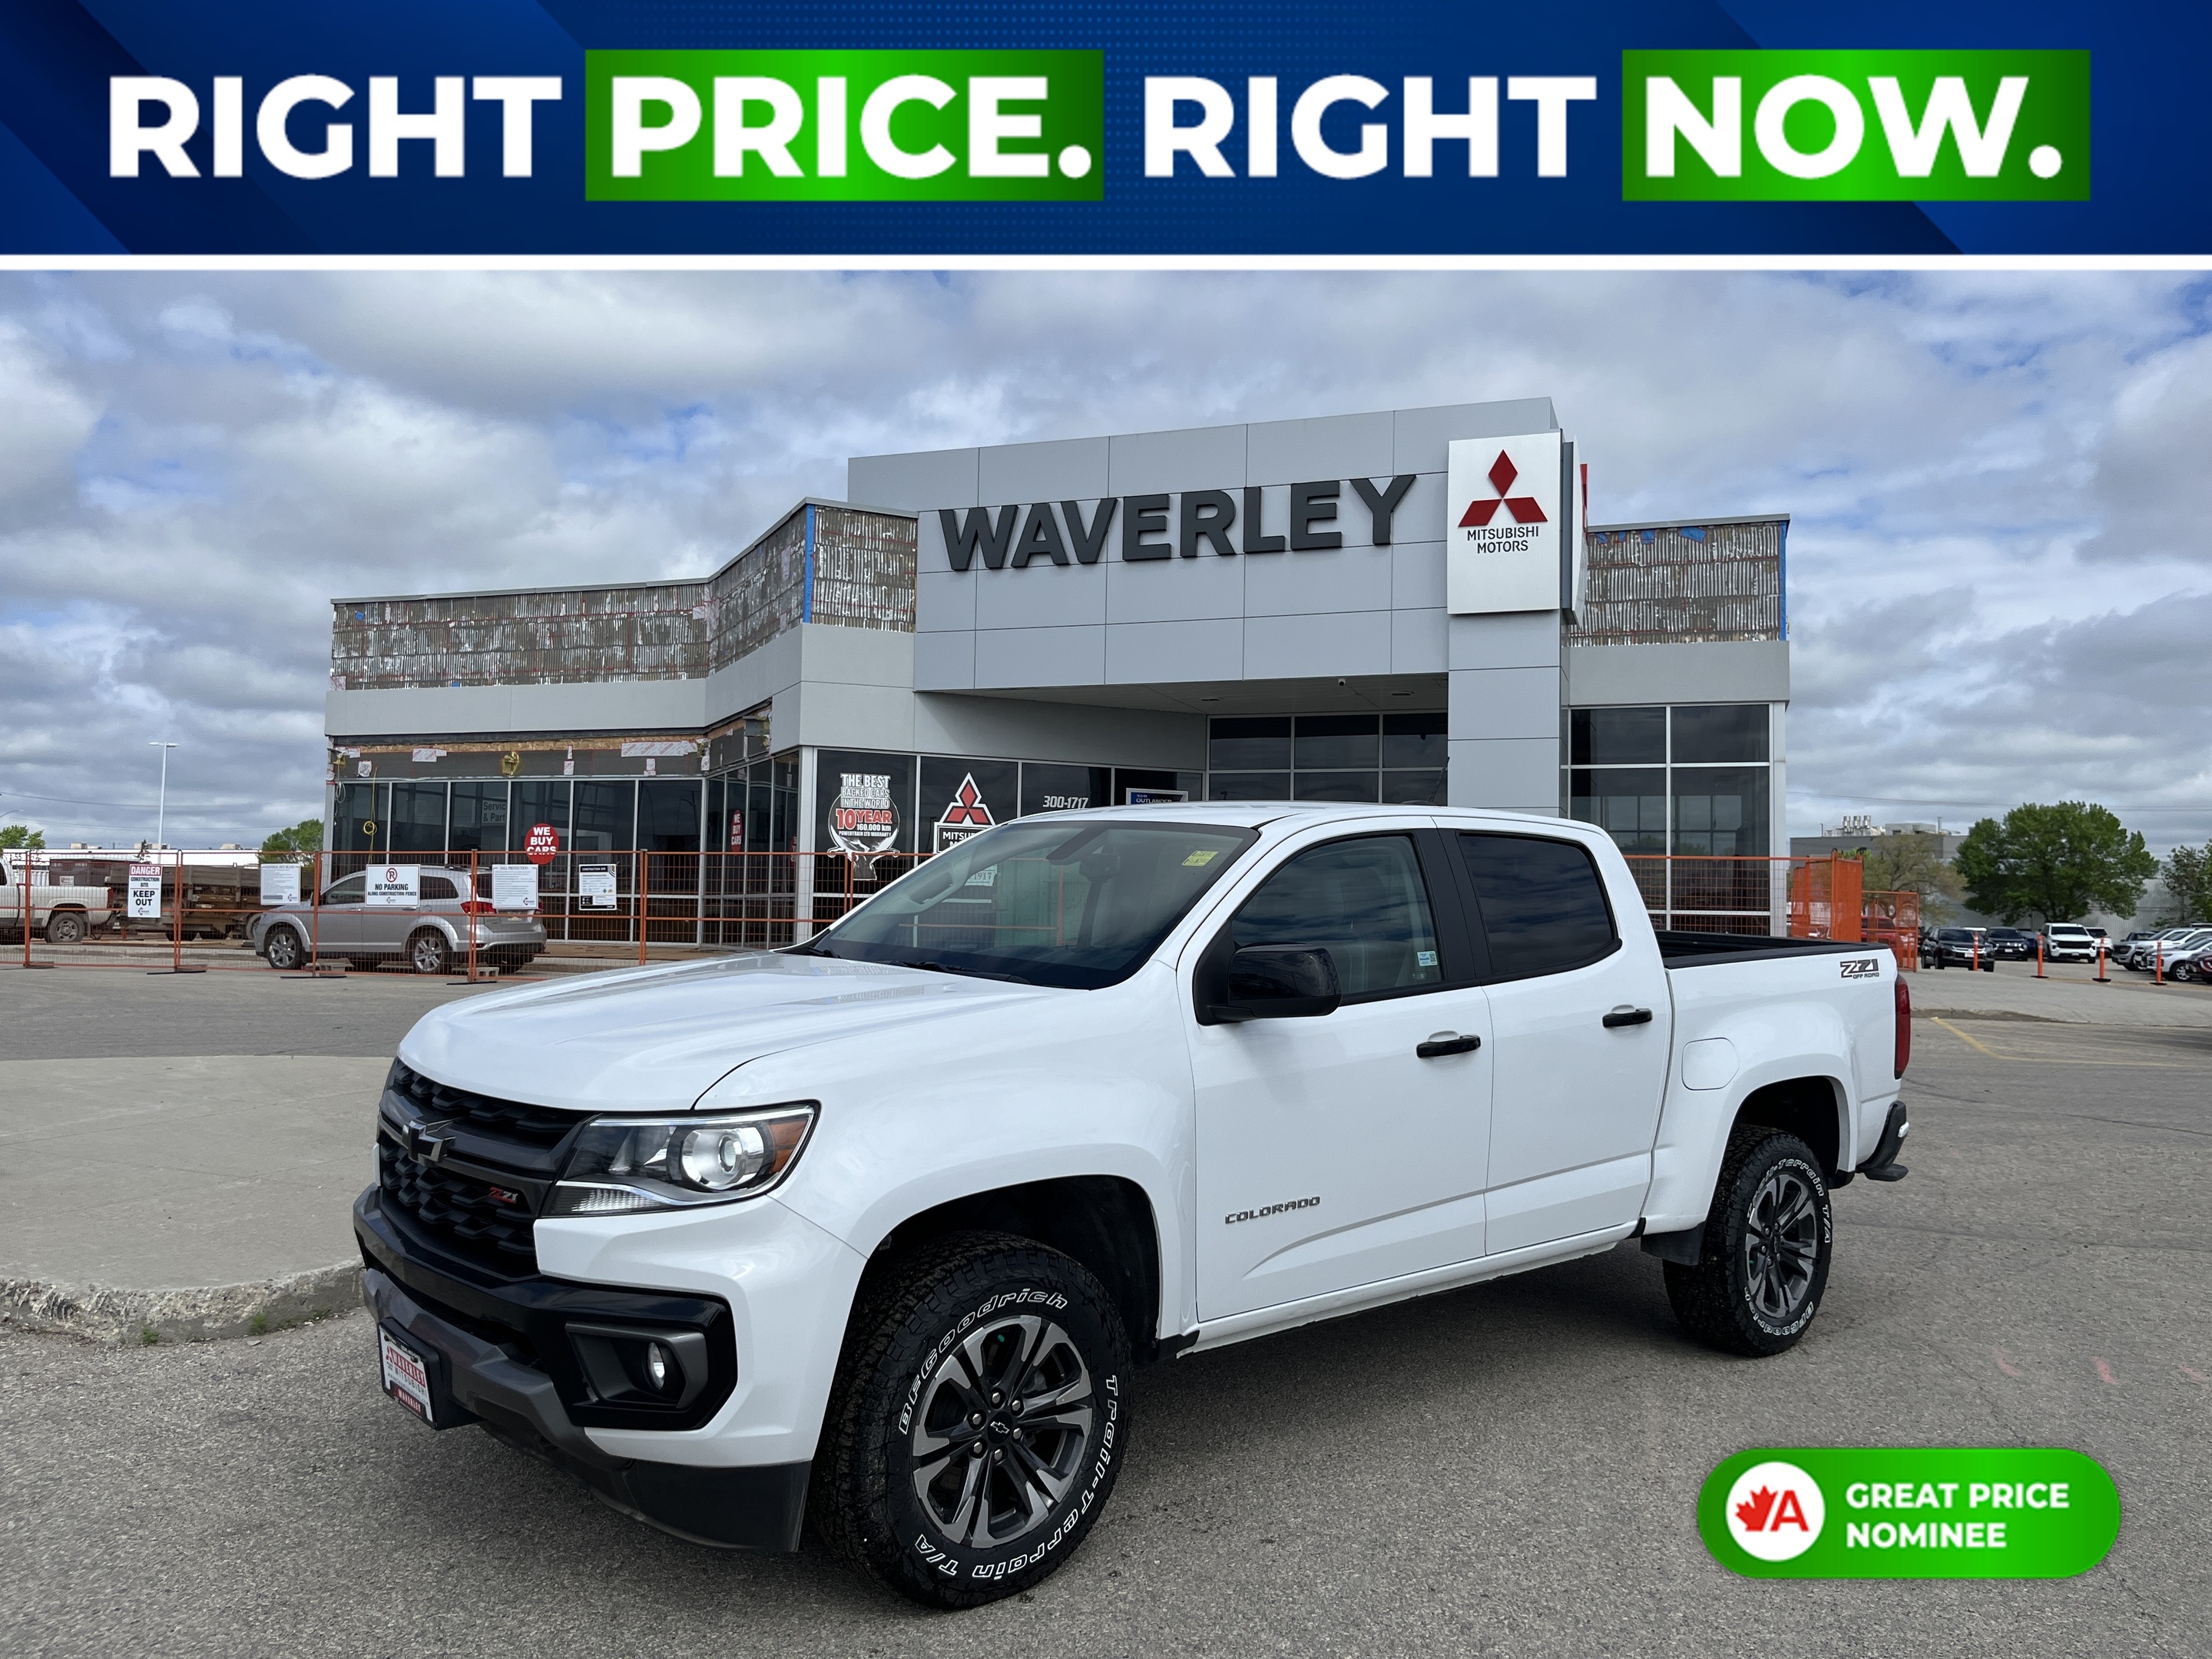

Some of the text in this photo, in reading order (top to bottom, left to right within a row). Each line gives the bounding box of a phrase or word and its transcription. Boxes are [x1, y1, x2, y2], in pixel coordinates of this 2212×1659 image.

[939, 474, 1416, 571] WAVERLEY
[1467, 526, 1539, 541] MITSUBISHI
[1477, 540, 1528, 554] MOTORS
[841, 774, 891, 788] THE BEST
[842, 787, 890, 798] BACKED CARS
[864, 799, 890, 808] WORLD
[1042, 796, 1089, 809] 300-1717
[733, 814, 740, 823] WE
[836, 809, 892, 830] 10 YEAR
[533, 826, 551, 836] WE
[733, 824, 741, 835] BUY
[530, 836, 554, 845] BUY
[731, 836, 741, 845] CARS
[527, 846, 556, 855] CARS
[131, 866, 161, 875] DANGER
[1839, 959, 1879, 979] Z71
[1225, 1196, 1320, 1224] COLORADO
[1820, 1204, 1831, 1243] T/A
[899, 1288, 1068, 1435] BFGoodrich
[915, 1375, 1118, 1580] Trail-Terrain T/A
